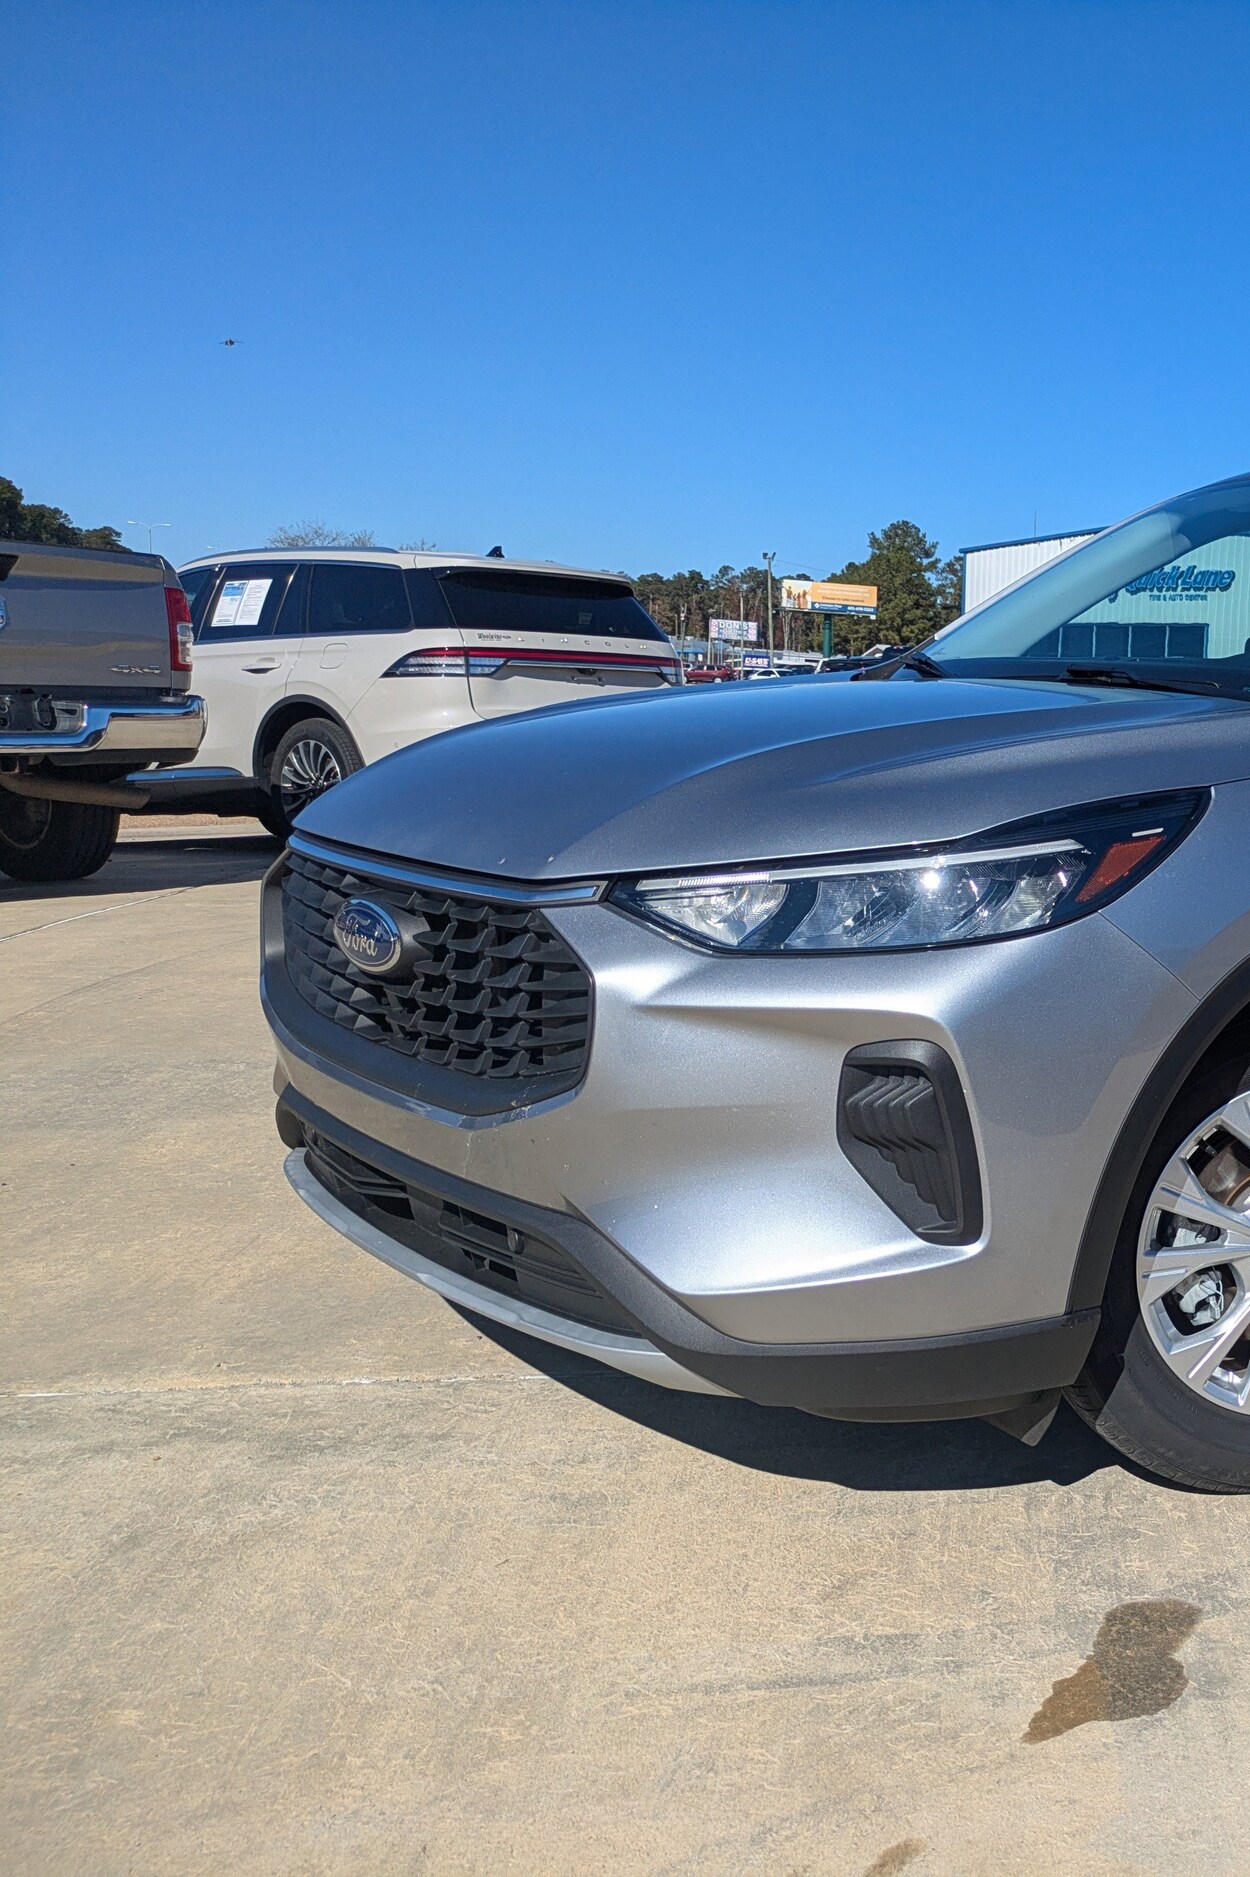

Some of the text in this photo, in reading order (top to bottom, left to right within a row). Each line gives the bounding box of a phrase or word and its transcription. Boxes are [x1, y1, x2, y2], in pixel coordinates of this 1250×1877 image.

[1126, 564, 1235, 596] uick Lane
[1184, 594, 1208, 602] CENTER
[719, 621, 748, 630] DON'S
[342, 912, 378, 956] Ford
